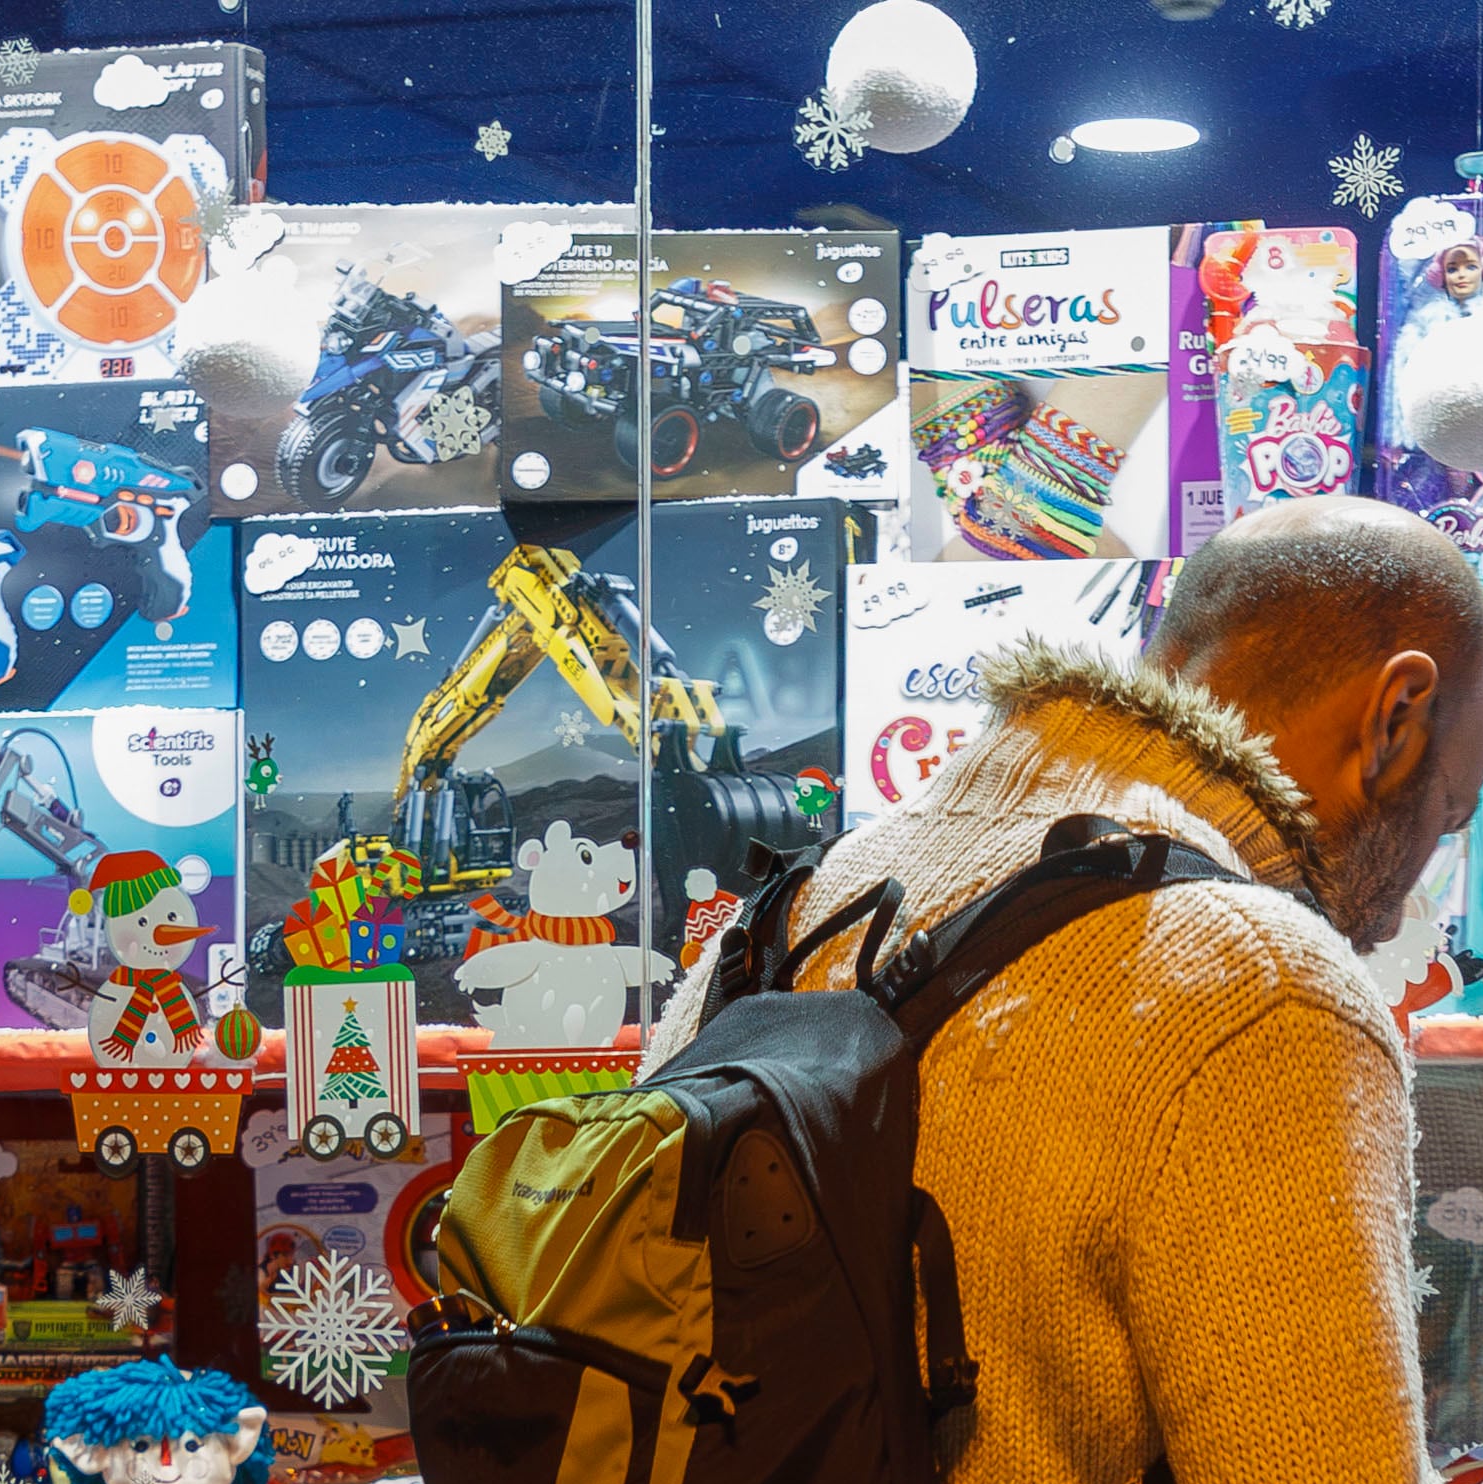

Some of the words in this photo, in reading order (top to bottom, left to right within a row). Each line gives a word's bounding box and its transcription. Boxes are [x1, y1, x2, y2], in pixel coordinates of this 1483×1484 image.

[816, 243, 883, 261] juguettos
[929, 279, 1122, 333] Pulseras
[959, 332, 1009, 352] entre
[1016, 329, 1090, 351] amigas
[1267, 396, 1344, 436] Barbie
[746, 514, 820, 534] juguettos
[151, 752, 193, 768] Tools
